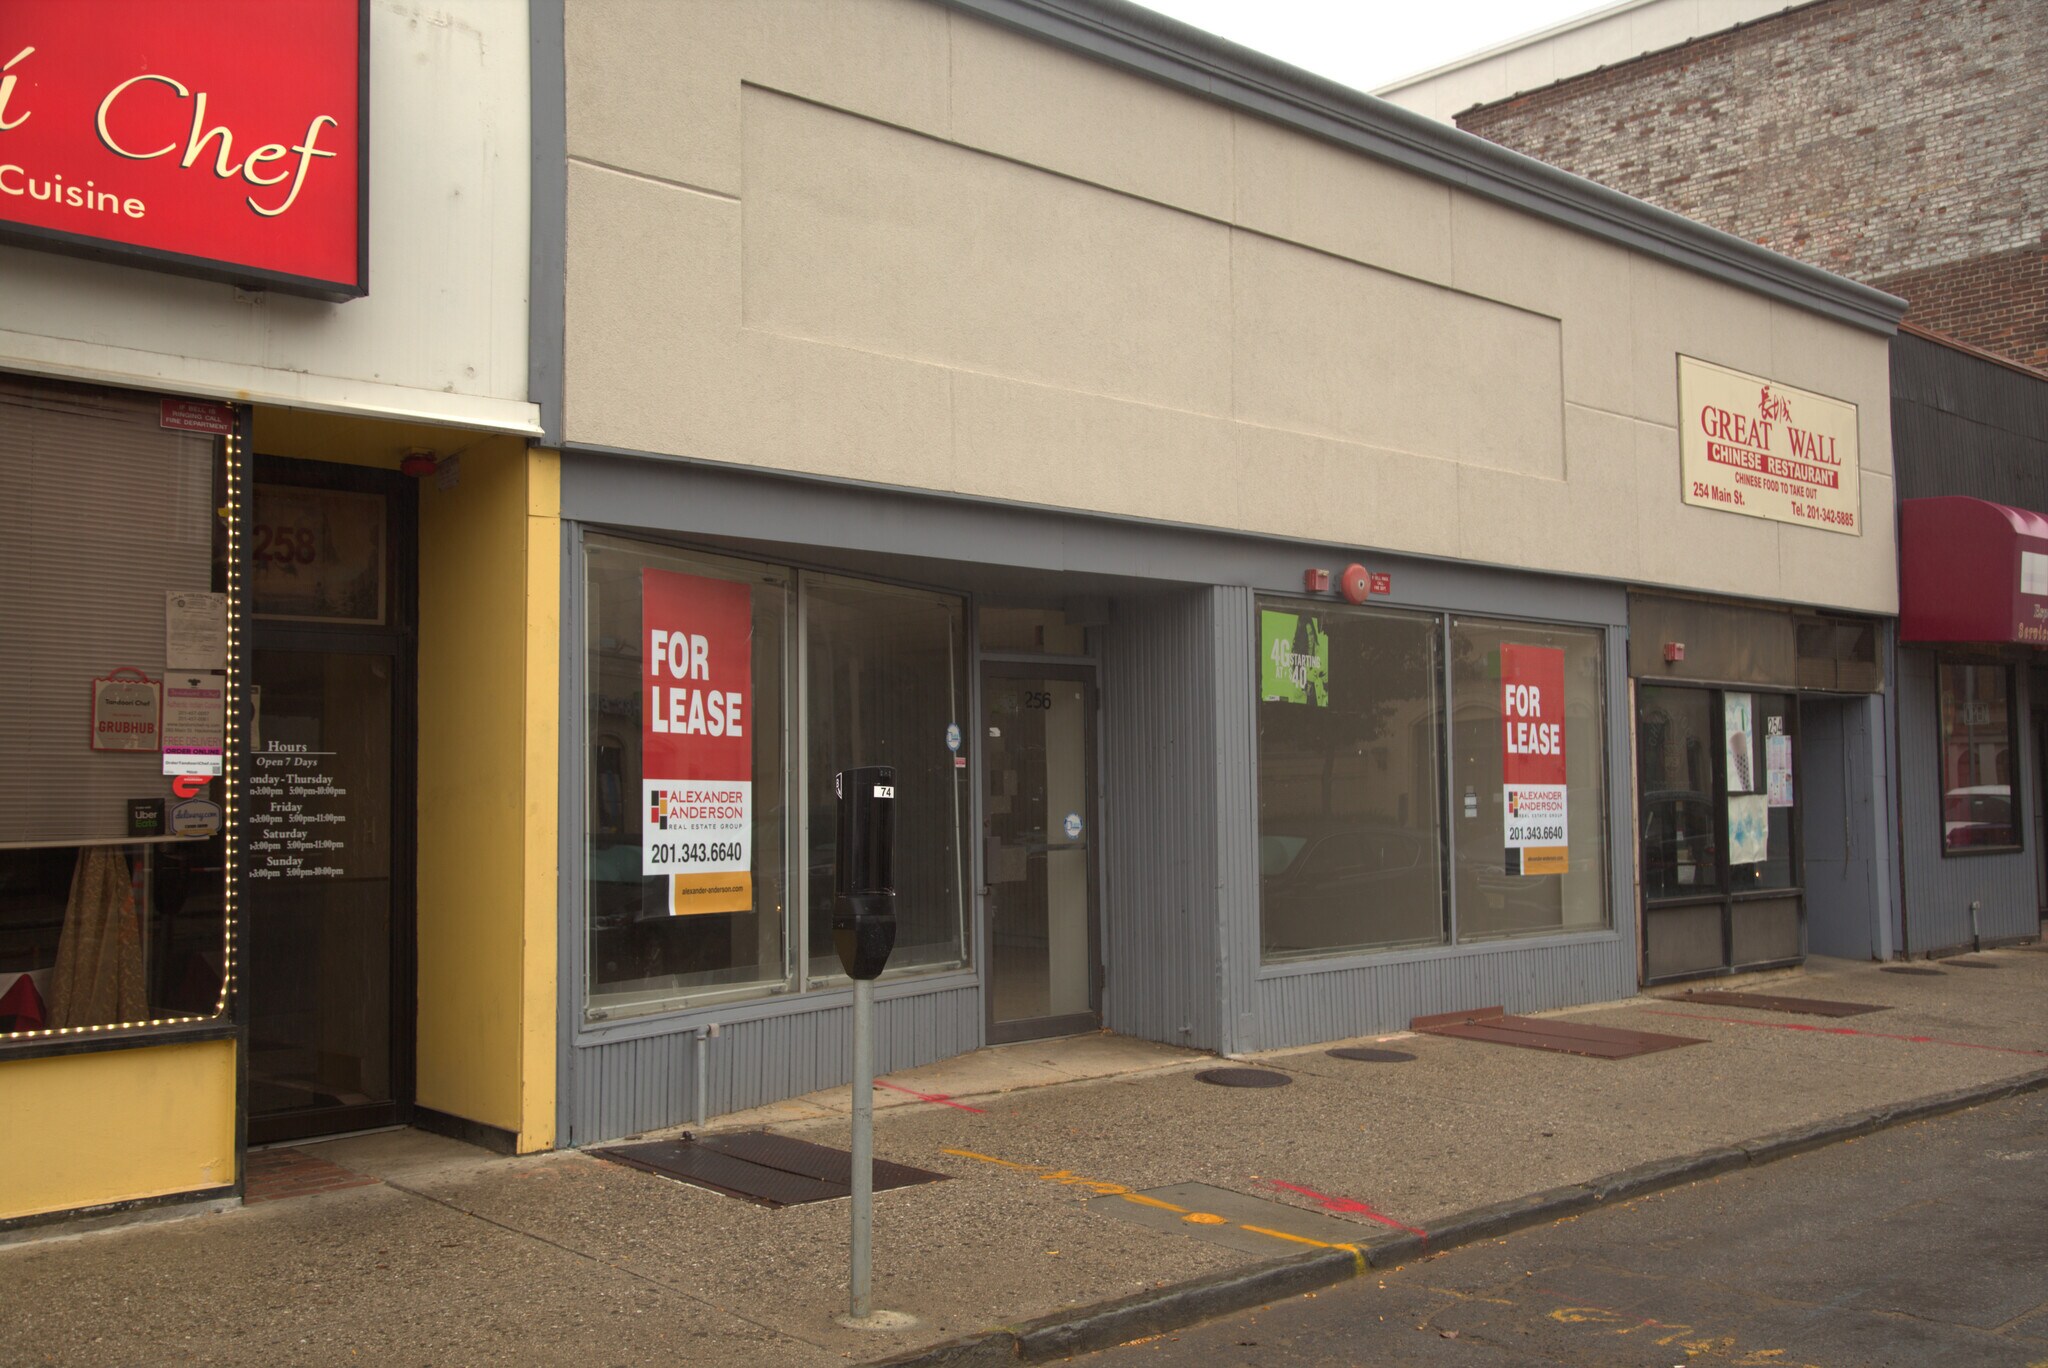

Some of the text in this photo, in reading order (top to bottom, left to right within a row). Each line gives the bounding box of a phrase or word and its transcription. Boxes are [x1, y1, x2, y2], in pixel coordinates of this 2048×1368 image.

[96, 74, 338, 217] Chef
[0, 164, 146, 218] Cuisine
[165, 417, 228, 430] FIRE DEPARTMENT
[205, 415, 222, 423] CALL
[1701, 405, 1841, 466] GREAT WALL
[1712, 444, 1834, 486] CHINESE RESTAURANT
[1735, 471, 1817, 499] CHINESE FOOD TO TAKE OUT
[1693, 481, 1745, 506] 254 Main St.
[1791, 501, 1854, 527] Tel. 201-342-5885
[252, 526, 316, 565] 258
[651, 629, 709, 681] FOR
[1271, 638, 1290, 667] 4G
[1290, 653, 1321, 669] STARTING
[1024, 691, 1052, 710] 256
[1505, 684, 1541, 717] FOR
[652, 686, 743, 737] LEASE
[99, 721, 154, 734] GRUBHUB
[1768, 717, 1782, 735] 254
[1506, 722, 1560, 755] LEASE
[268, 740, 308, 752] Hours
[256, 757, 318, 767] Open 7 Days
[250, 774, 280, 786] onday
[286, 774, 334, 786] Thursday
[669, 790, 743, 803] ALEXANDER
[880, 787, 891, 797] 74
[1519, 791, 1562, 800] ALEXANDER
[270, 802, 302, 814] Friday
[669, 806, 743, 819] ANDERSON
[1519, 801, 1563, 811] ANDERSON
[135, 810, 157, 819] Uber
[135, 820, 158, 828] Eats
[263, 828, 308, 840] Saturday
[1509, 826, 1563, 840] 201.343.6640
[651, 842, 742, 863] 201.343.6640
[267, 856, 304, 868] Sunday
[681, 886, 744, 895] alexander-anderson.com
